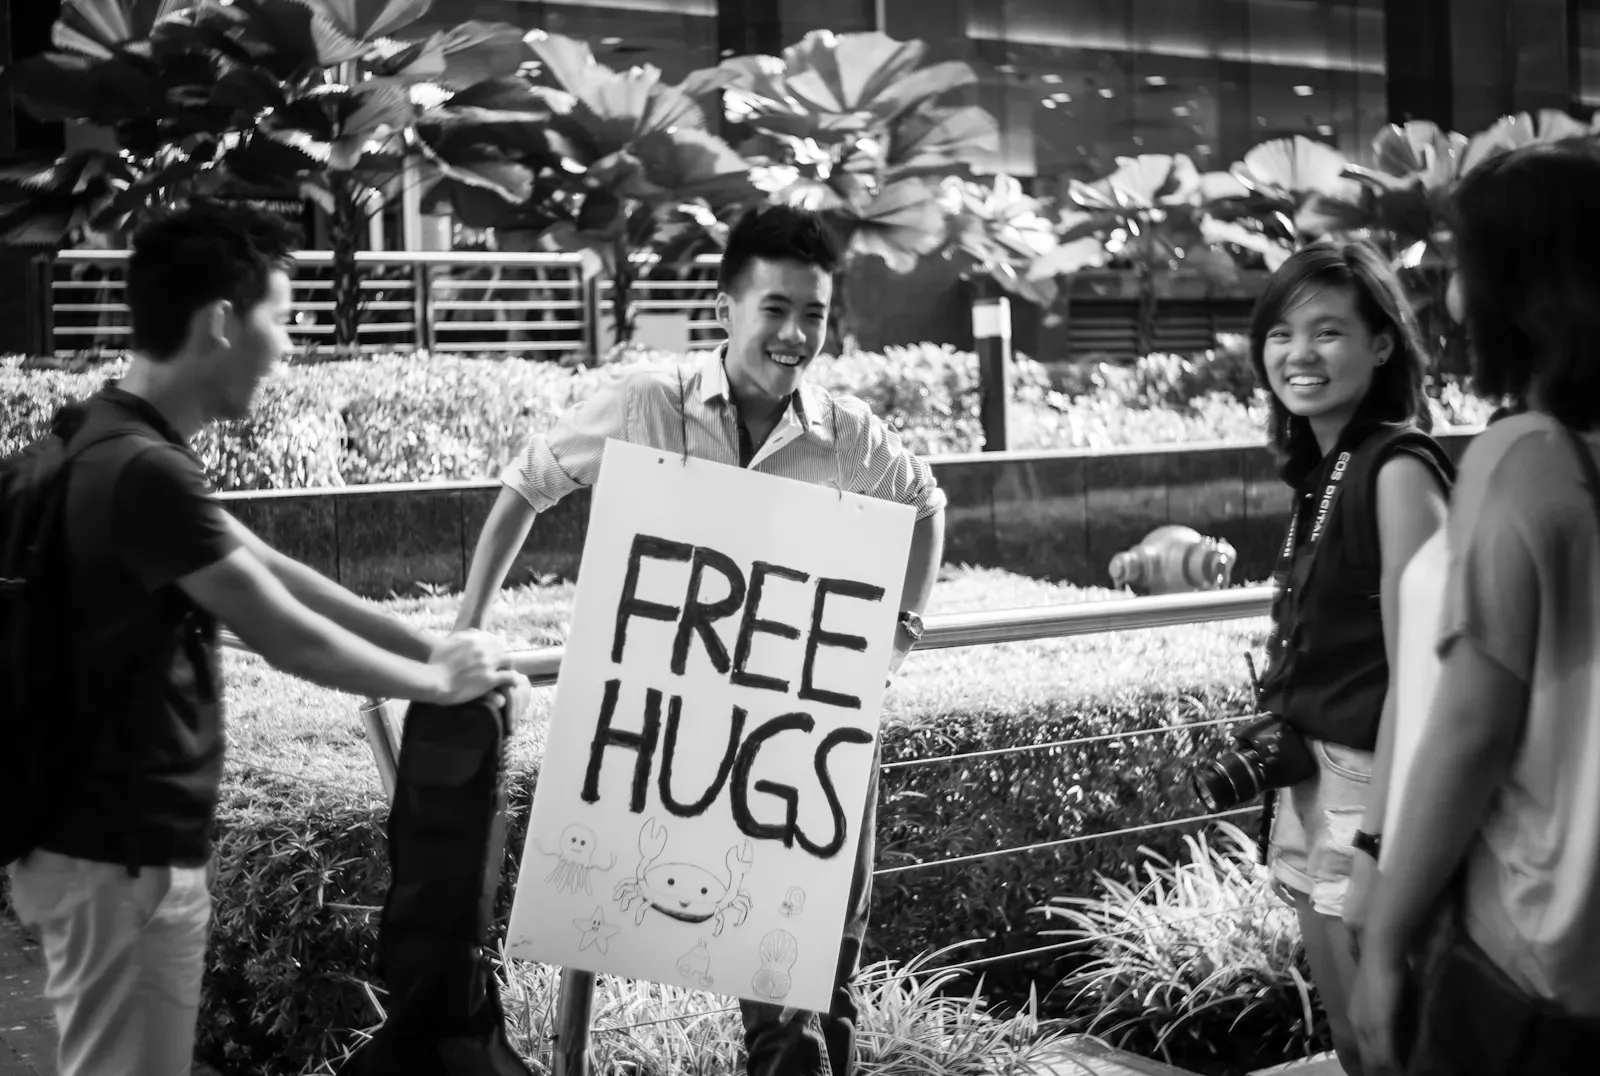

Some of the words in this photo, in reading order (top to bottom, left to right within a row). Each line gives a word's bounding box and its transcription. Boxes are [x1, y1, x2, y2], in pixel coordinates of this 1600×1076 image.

[1310, 485, 1337, 542] DIGITAL
[1330, 451, 1351, 481] EOS
[611, 533, 886, 710] FREE
[580, 678, 874, 860] HUGS
